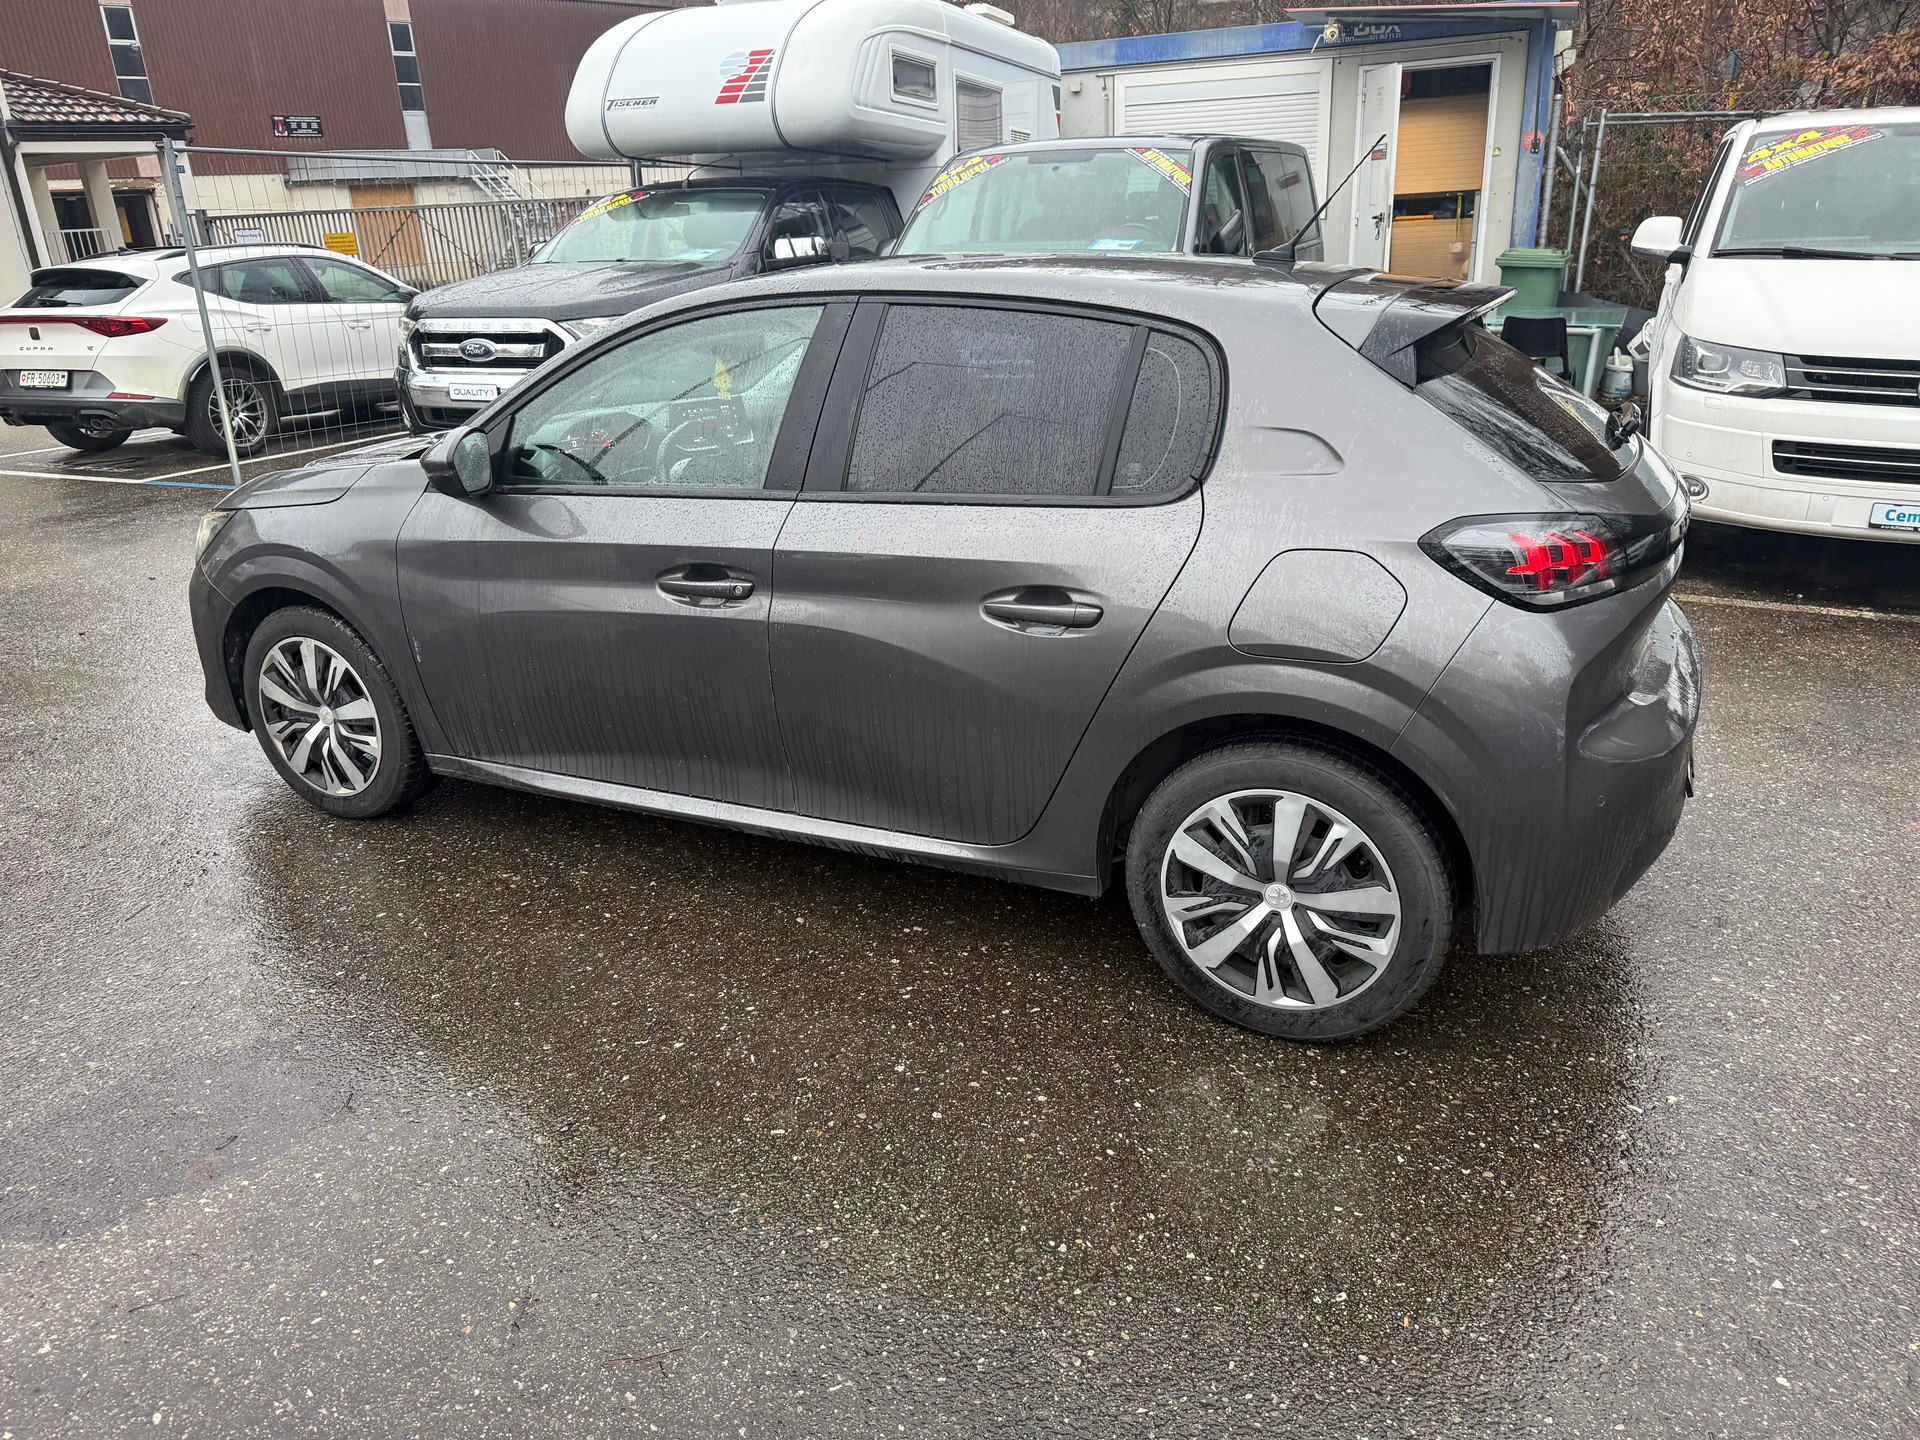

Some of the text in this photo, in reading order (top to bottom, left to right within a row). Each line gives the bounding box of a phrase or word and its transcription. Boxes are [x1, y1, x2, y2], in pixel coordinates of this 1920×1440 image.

[606, 96, 659, 111] TISCHER
[1763, 134, 1853, 171] AUTOMATIQUE
[960, 161, 991, 181] DIESEL
[464, 343, 485, 355] Ford
[453, 388, 489, 396] QUALITY
